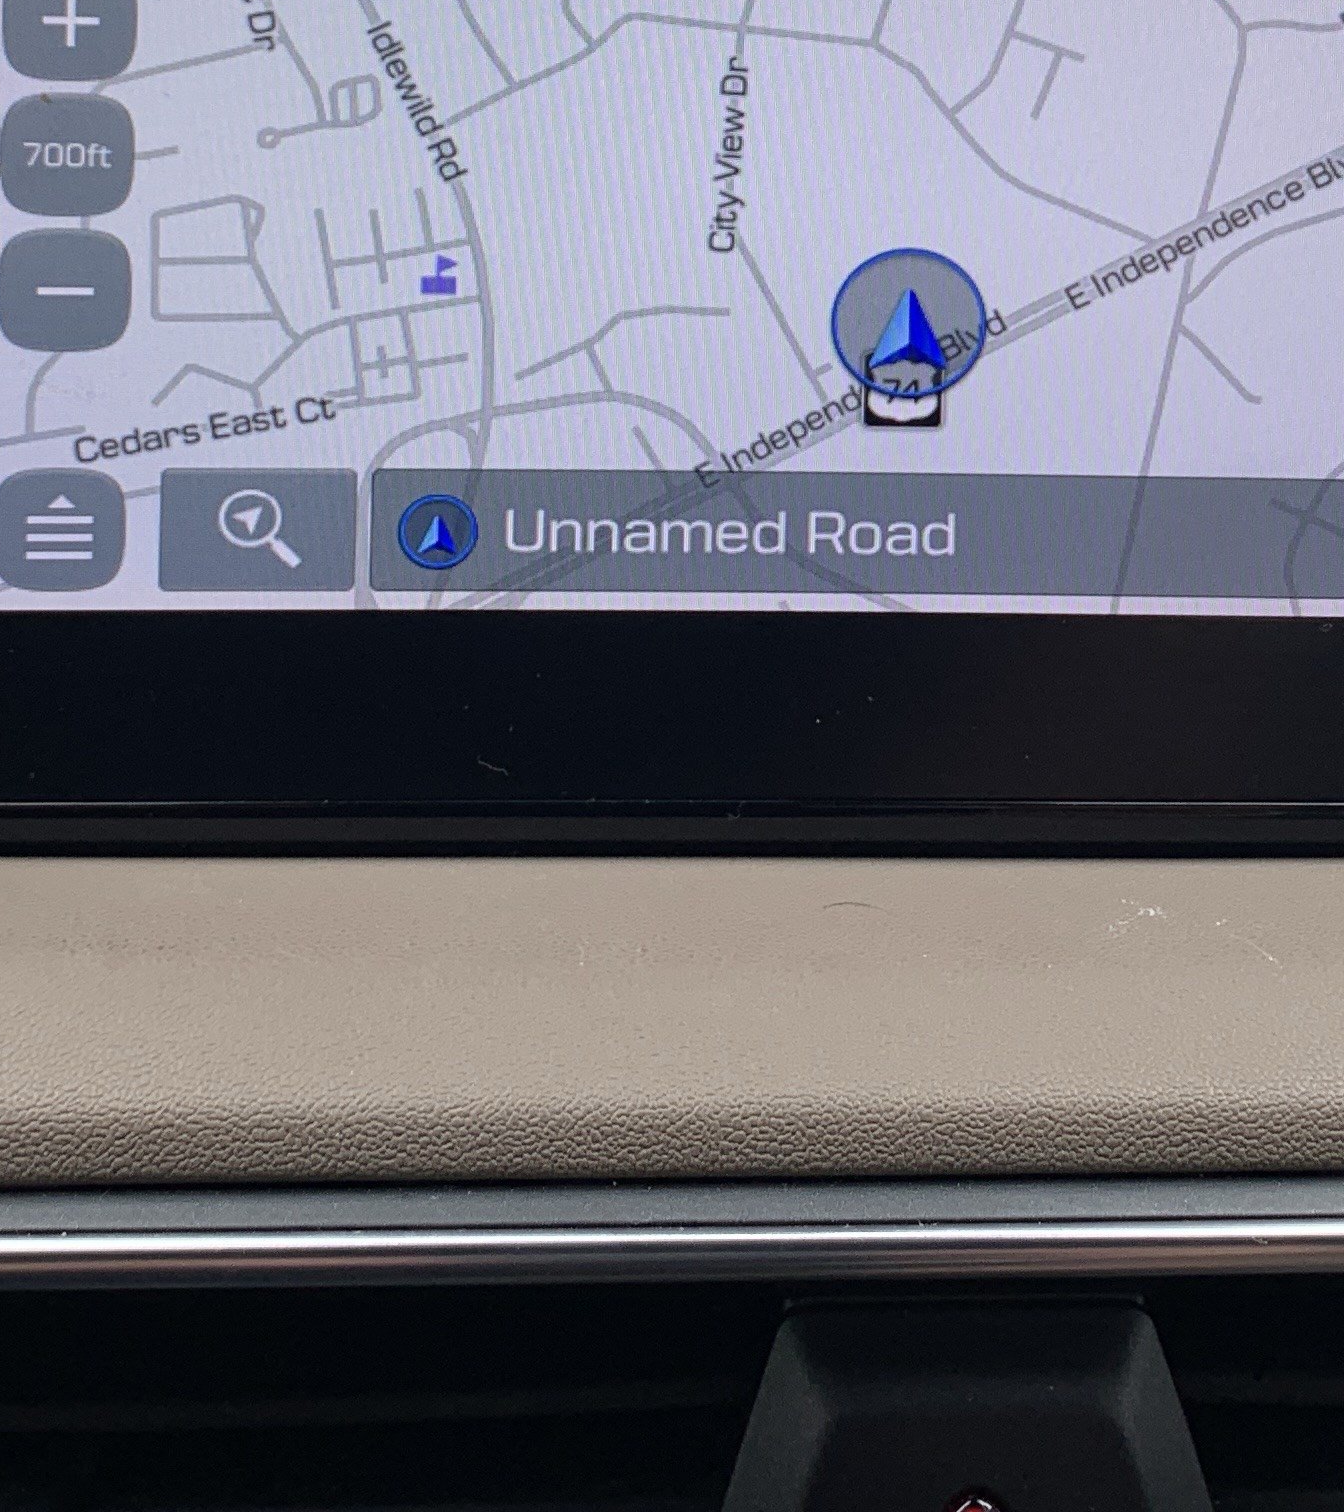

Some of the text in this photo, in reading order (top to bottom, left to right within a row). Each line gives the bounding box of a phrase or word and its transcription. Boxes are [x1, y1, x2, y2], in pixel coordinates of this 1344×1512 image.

[247, 10, 277, 51] Dr
[368, 20, 467, 182] Idlewild Rd
[23, 141, 112, 168] 700ft
[707, 56, 748, 254] City View Dr
[1064, 283, 1088, 311] E
[1091, 178, 1306, 295] Independence
[74, 397, 336, 463] Cedars East Ct
[693, 461, 721, 490] E
[720, 384, 863, 474] Independ
[504, 509, 957, 557] Unnamed Road
